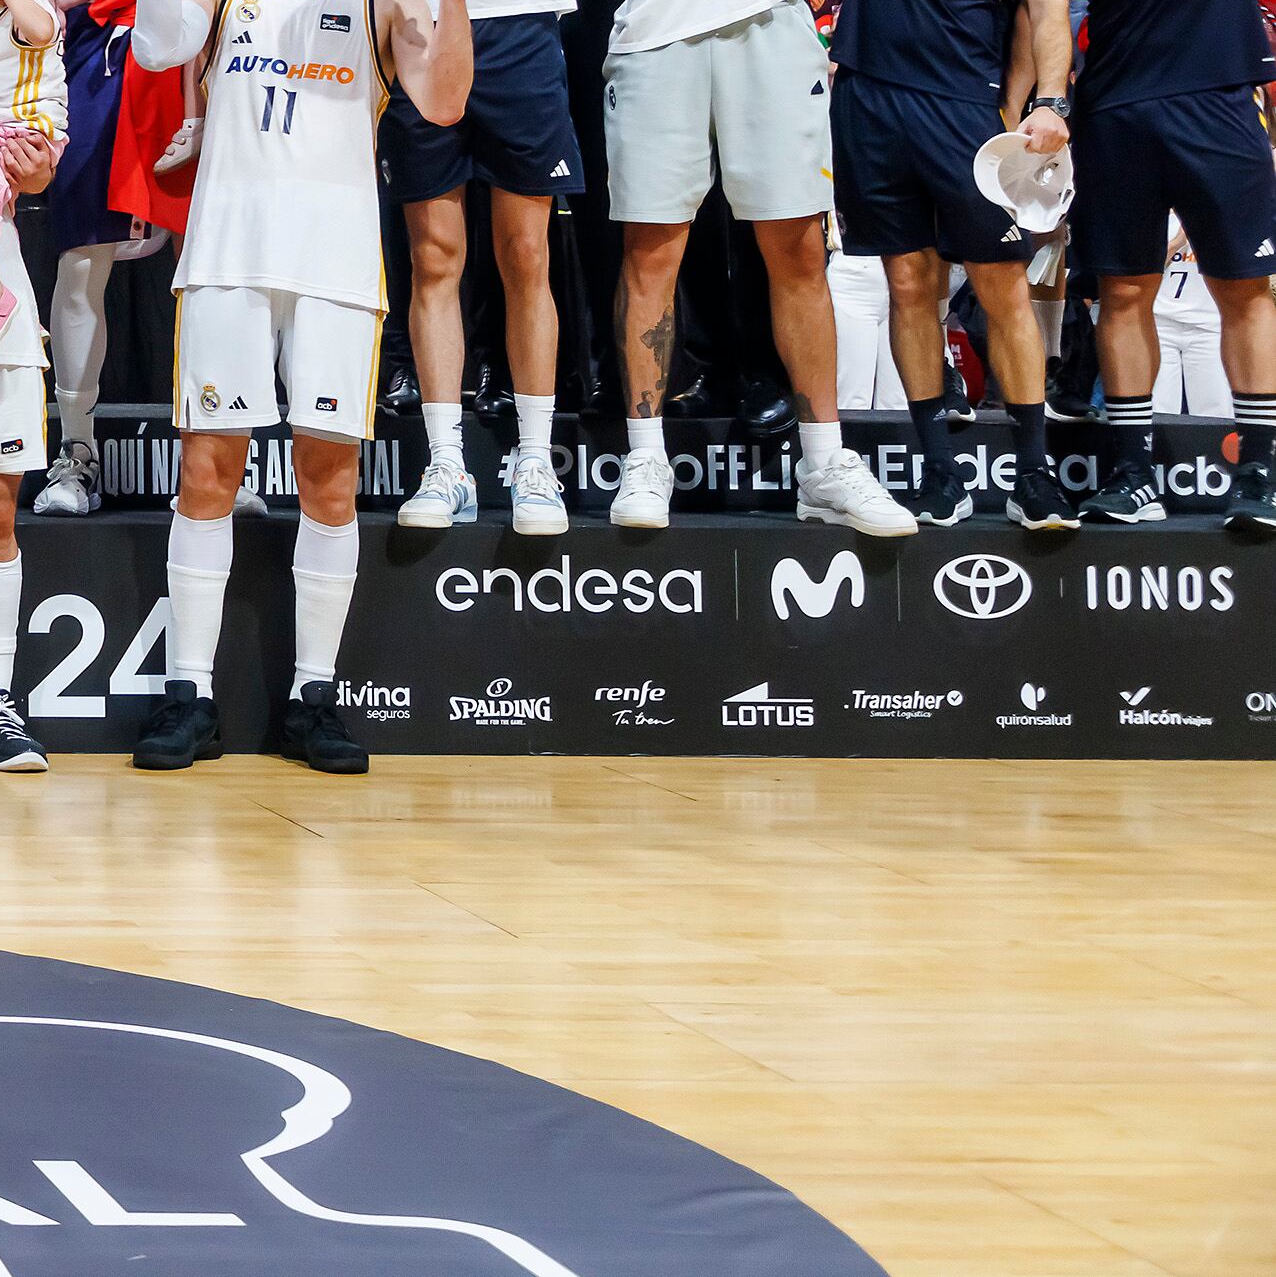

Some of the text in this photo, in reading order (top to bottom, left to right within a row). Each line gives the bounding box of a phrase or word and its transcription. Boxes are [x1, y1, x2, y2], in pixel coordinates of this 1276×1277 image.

[226, 55, 354, 85] AUTOHERO
[259, 85, 297, 135] 11
[1170, 272, 1188, 299] 7
[317, 402, 333, 410] acb
[3, 445, 20, 454] acb
[435, 554, 702, 614] endesa
[1086, 565, 1235, 612] IONOS
[26, 593, 176, 718] 24
[337, 681, 411, 708] divina
[595, 680, 666, 708] renfe
[851, 690, 945, 710] Transaher
[366, 708, 411, 722] seguros
[449, 695, 552, 722] SPALDING
[613, 710, 674, 725] Tu tren
[722, 705, 814, 727] LOTUS
[870, 710, 932, 720] Smart Logistics
[1119, 709, 1212, 726] Halcón viajes
